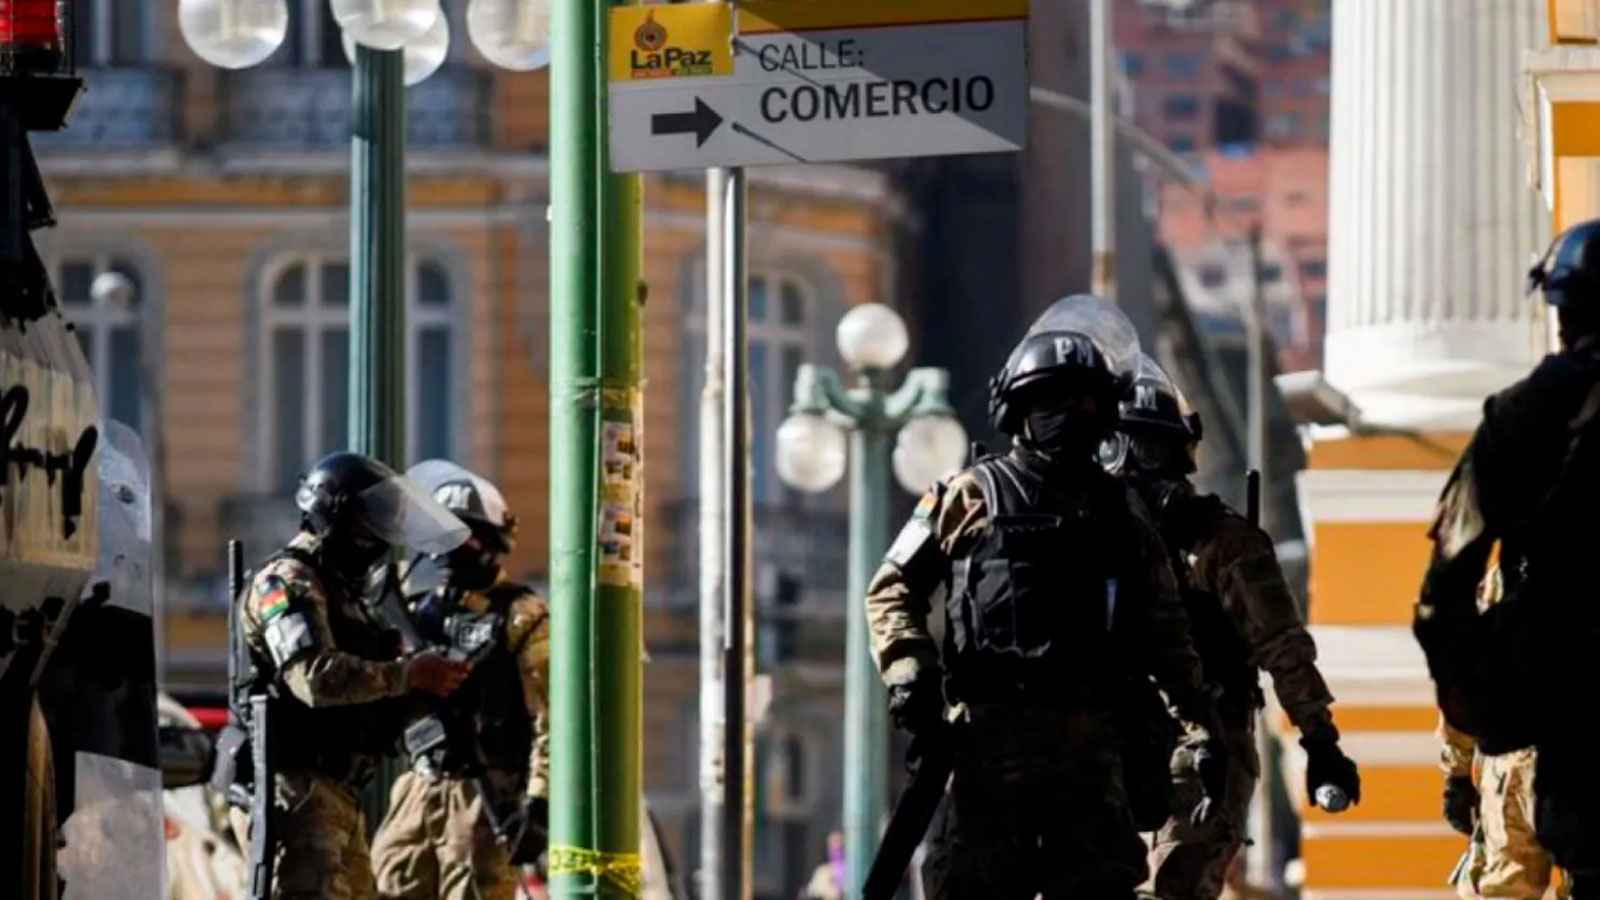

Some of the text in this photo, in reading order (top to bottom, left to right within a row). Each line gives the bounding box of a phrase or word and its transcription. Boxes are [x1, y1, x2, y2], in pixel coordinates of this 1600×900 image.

[760, 40, 864, 71] CALLE:
[760, 75, 995, 123] COMERCIO
[1054, 336, 1094, 367] PM
